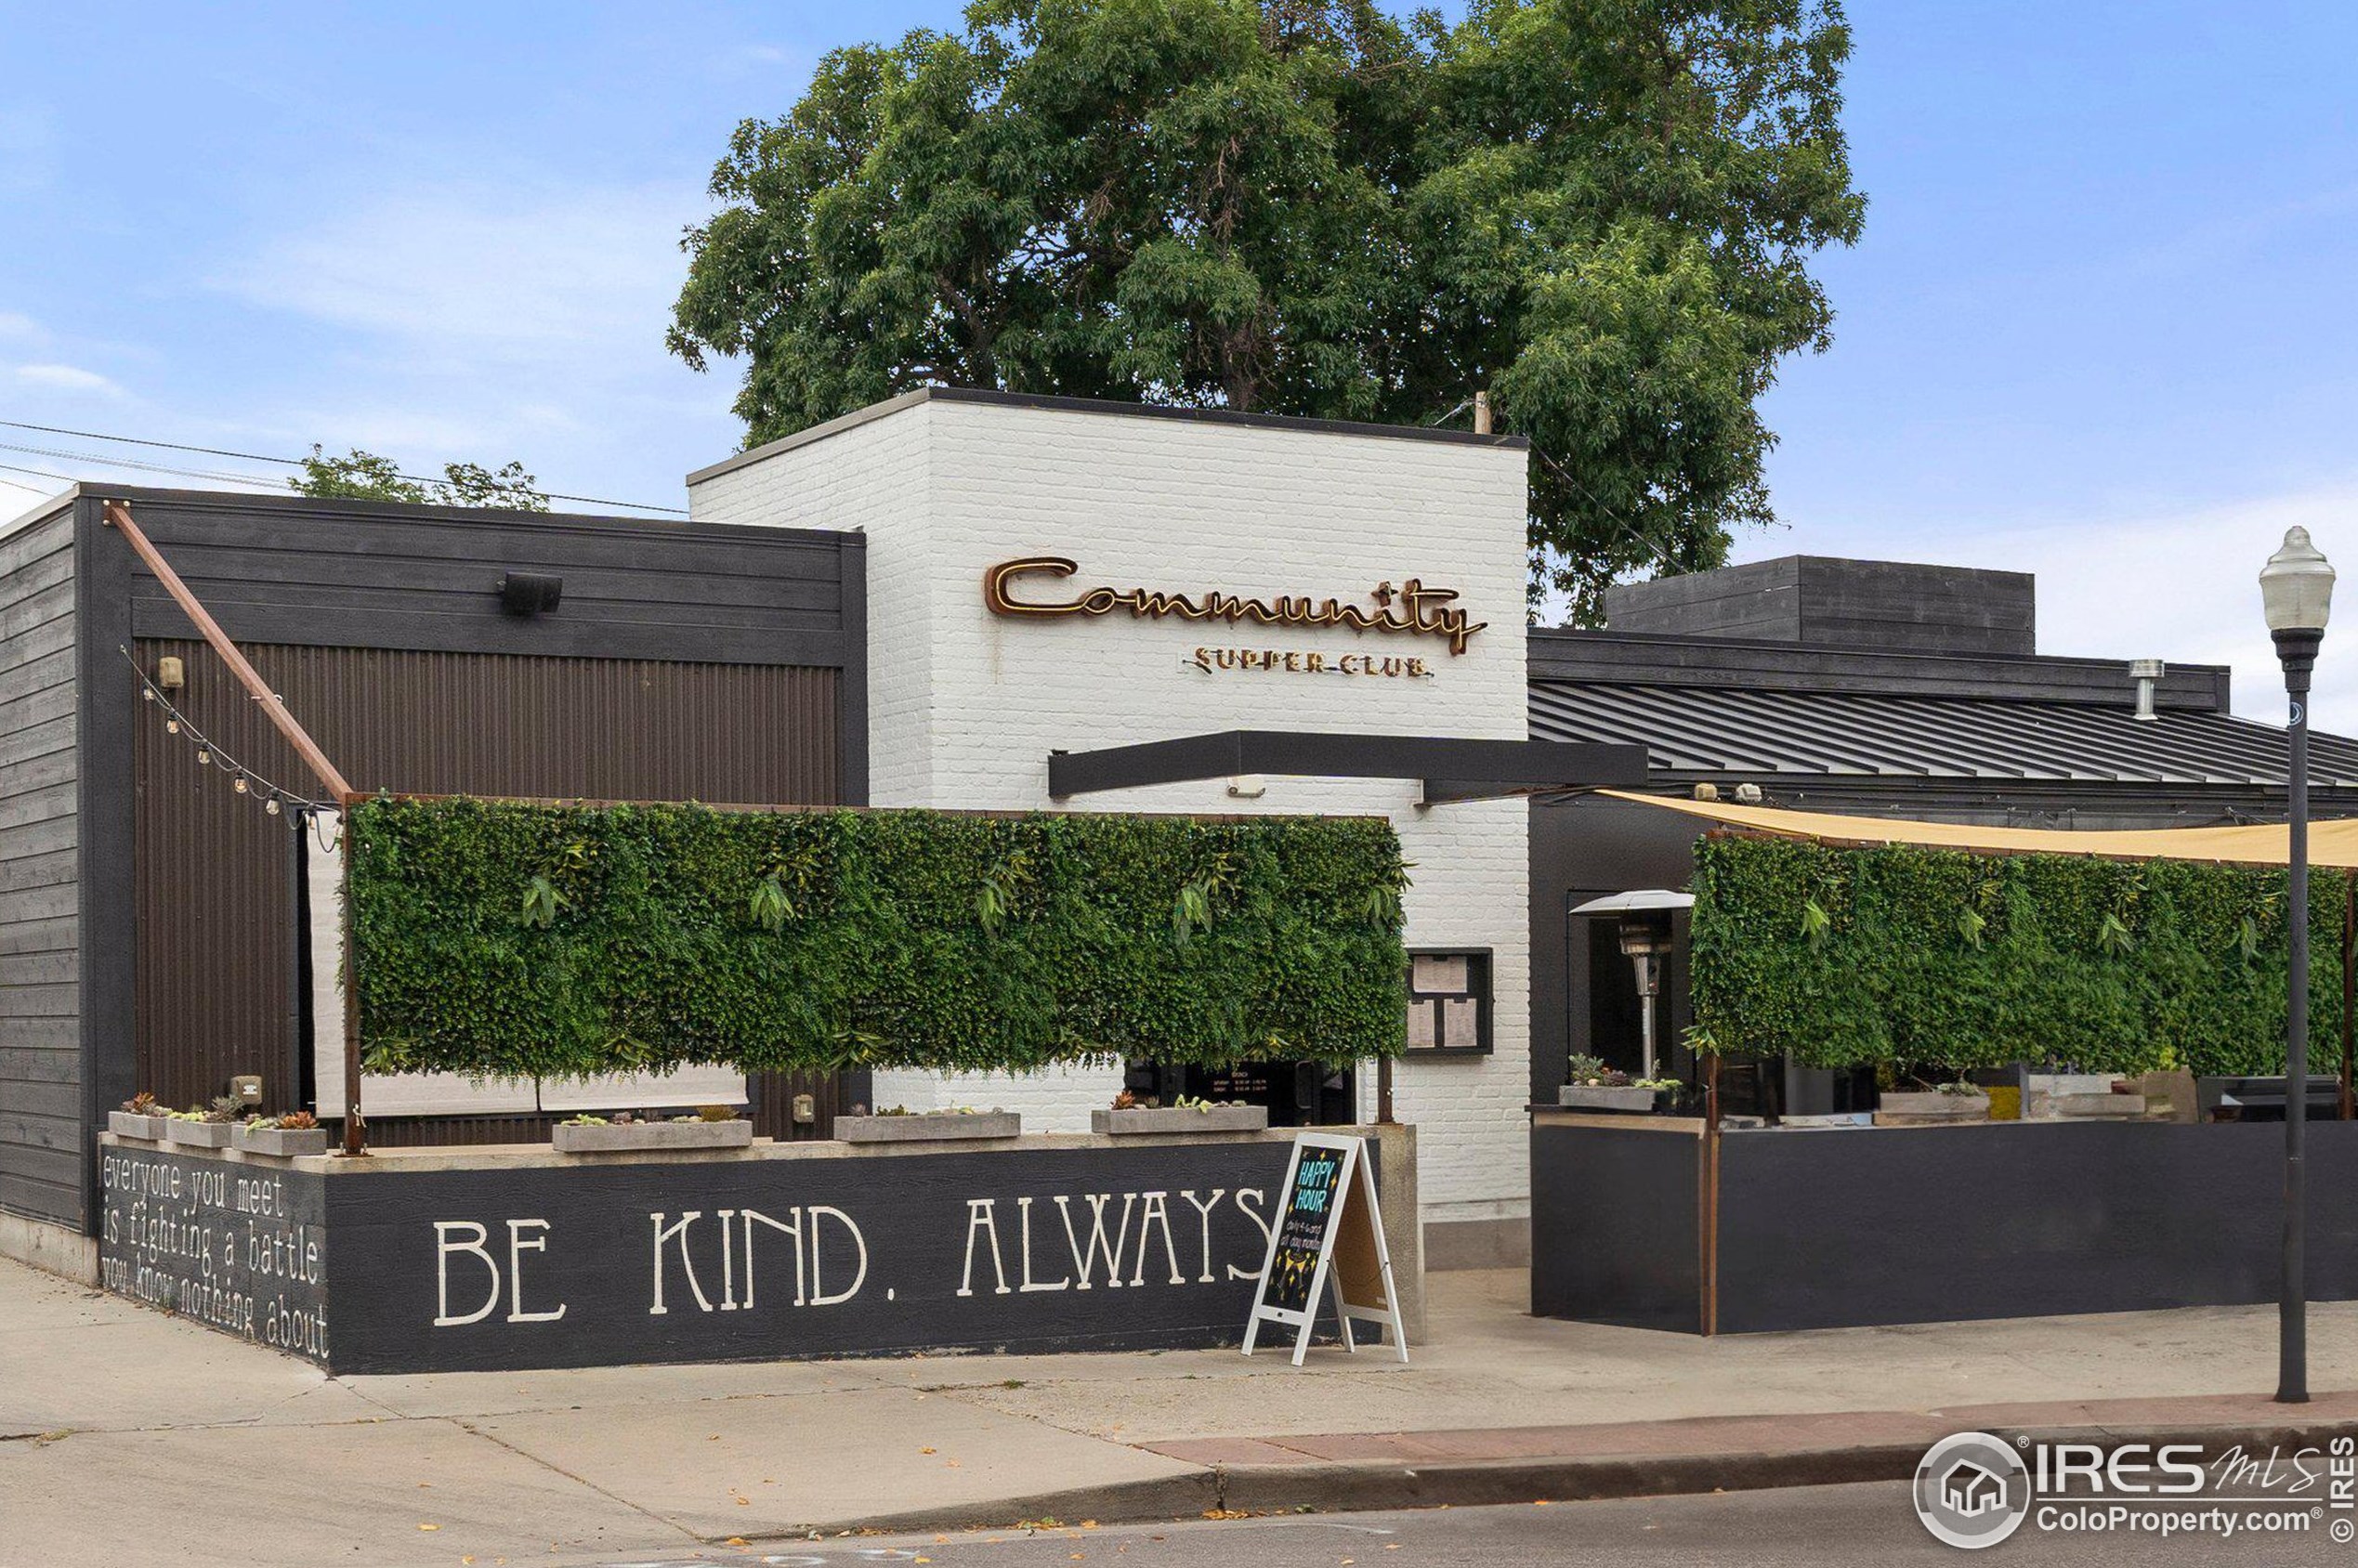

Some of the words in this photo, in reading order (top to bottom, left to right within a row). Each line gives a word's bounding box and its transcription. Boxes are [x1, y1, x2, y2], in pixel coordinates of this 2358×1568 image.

[984, 556, 1487, 656] Community
[1195, 647, 1324, 673] SUPPER
[1339, 654, 1426, 678] CLUB
[103, 1155, 181, 1205] everyone
[191, 1170, 226, 1215] you
[237, 1175, 283, 1218] meet
[1295, 1189, 1328, 1213] HOUR
[1297, 1160, 1336, 1189] HAPPY
[102, 1195, 120, 1245] is
[129, 1202, 212, 1278] fighting
[225, 1231, 235, 1266] a
[247, 1220, 319, 1285] battle
[433, 1219, 568, 1326] BE
[648, 1206, 895, 1314] KIND.
[956, 1187, 1273, 1297] ALWAYS
[101, 1256, 127, 1294] you
[136, 1251, 174, 1308] know
[181, 1274, 255, 1340] nothing
[266, 1294, 330, 1360] about
